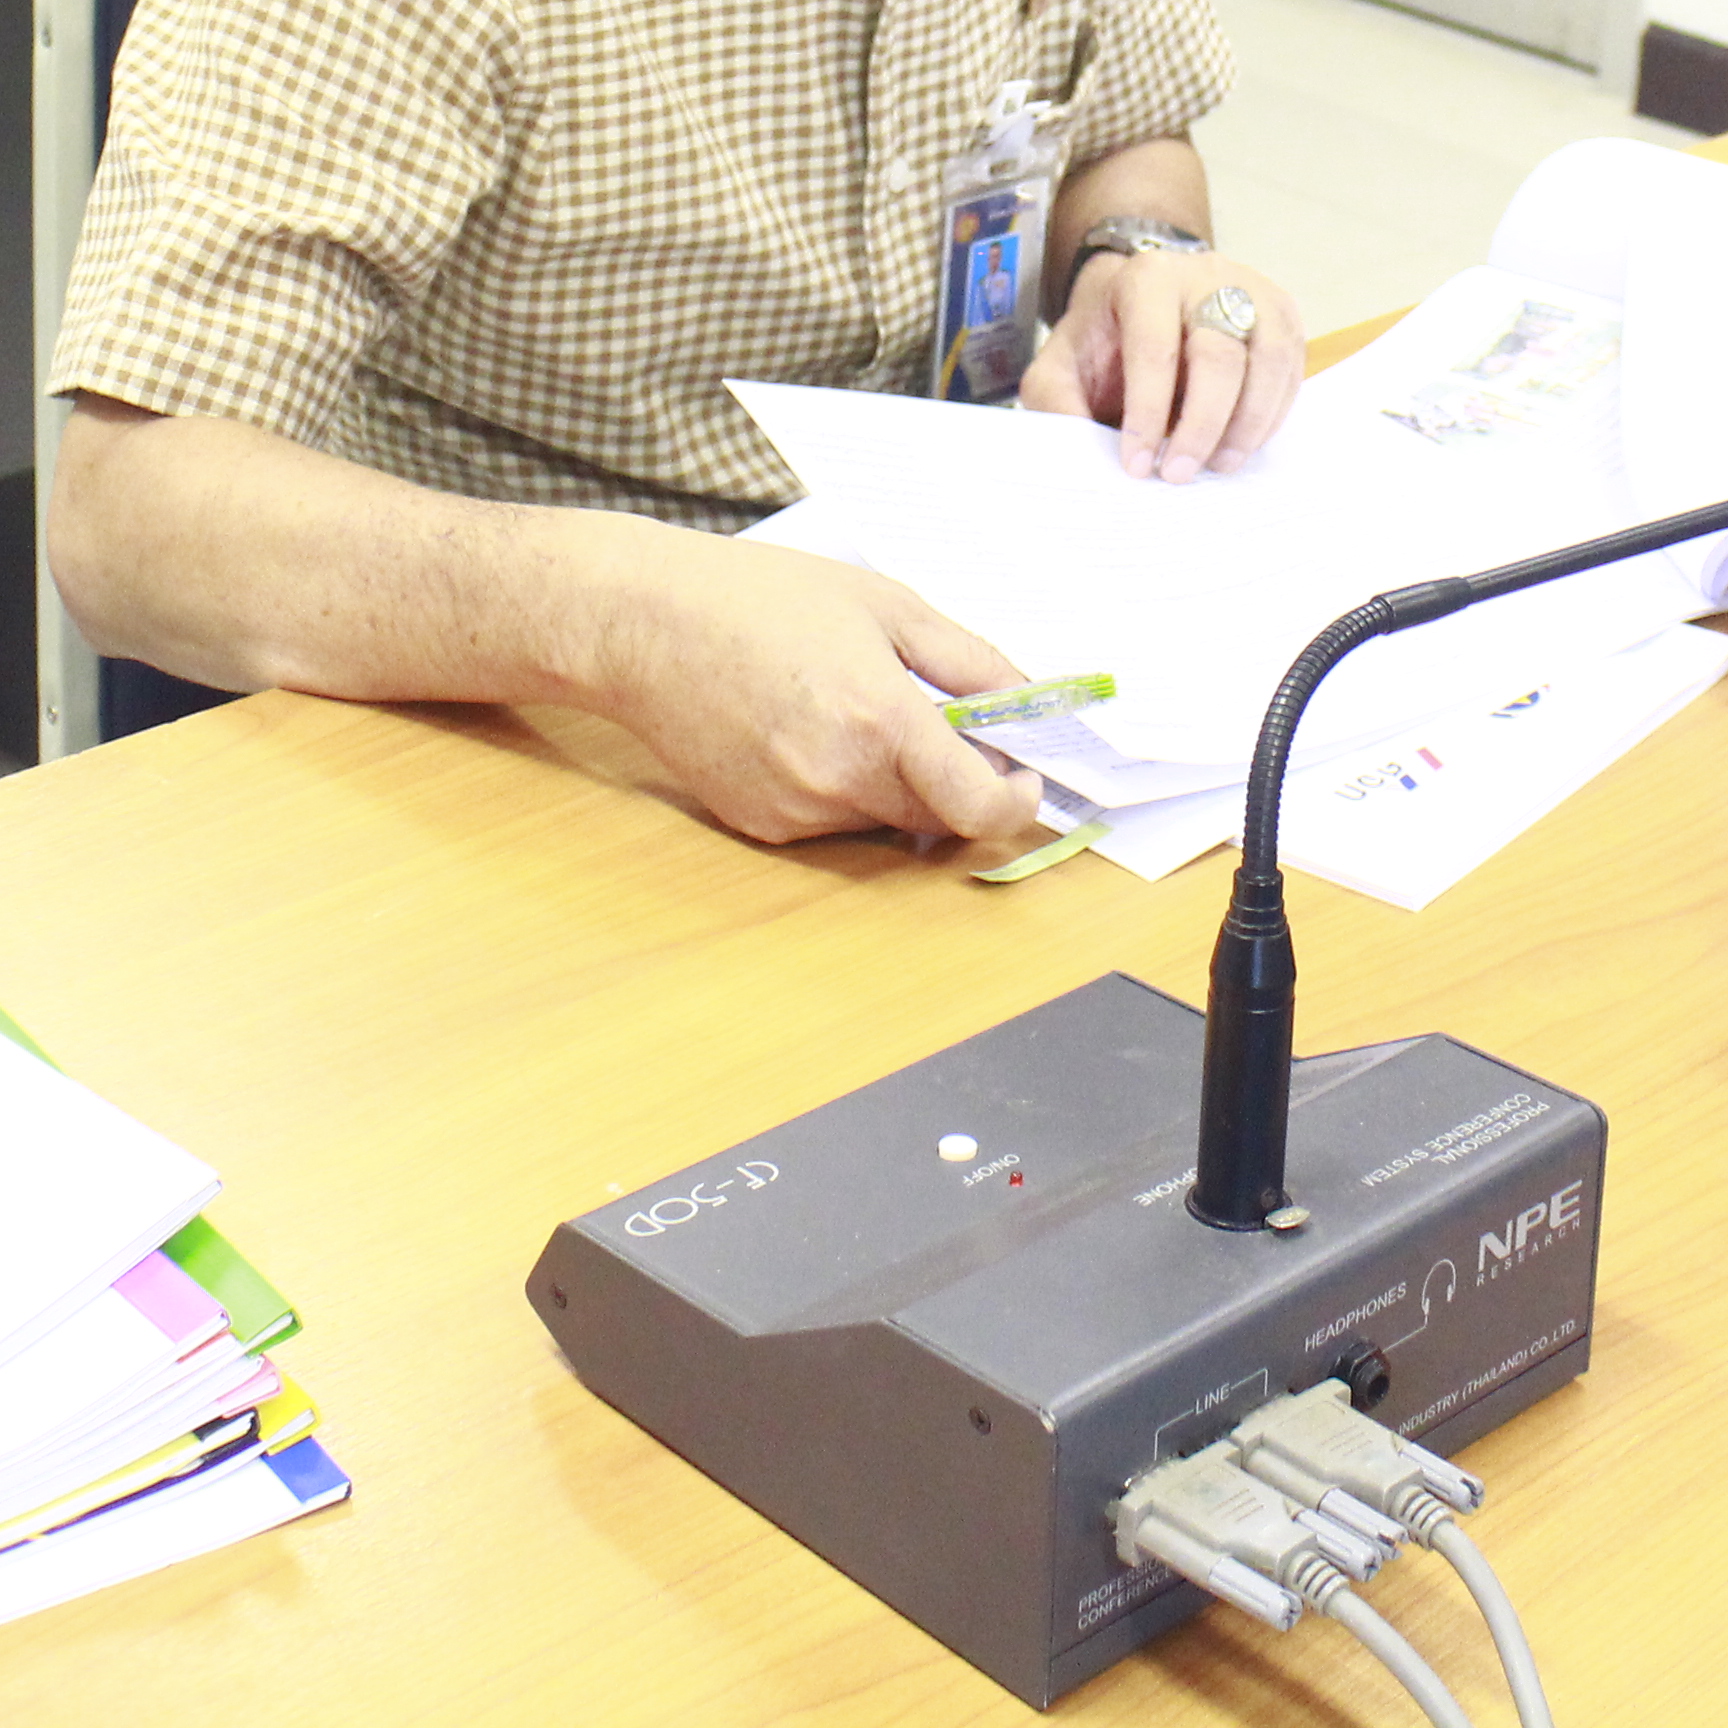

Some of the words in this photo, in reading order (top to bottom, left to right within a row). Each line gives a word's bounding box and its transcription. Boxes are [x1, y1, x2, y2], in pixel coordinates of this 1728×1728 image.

[1423, 1091, 1531, 1152] CONFERENCE
[1429, 1100, 1551, 1165] PROFESSIONAL
[1359, 1147, 1430, 1186] SYSTEM
[1476, 1217, 1581, 1286] RESEARCH
[1478, 1178, 1582, 1272] NPE
[1306, 1281, 1407, 1352] HEADPHONES
[1195, 1381, 1231, 1415] LINE
[1399, 1390, 1457, 1436] INDUSTRY
[1463, 1347, 1528, 1401] (THAILAND)
